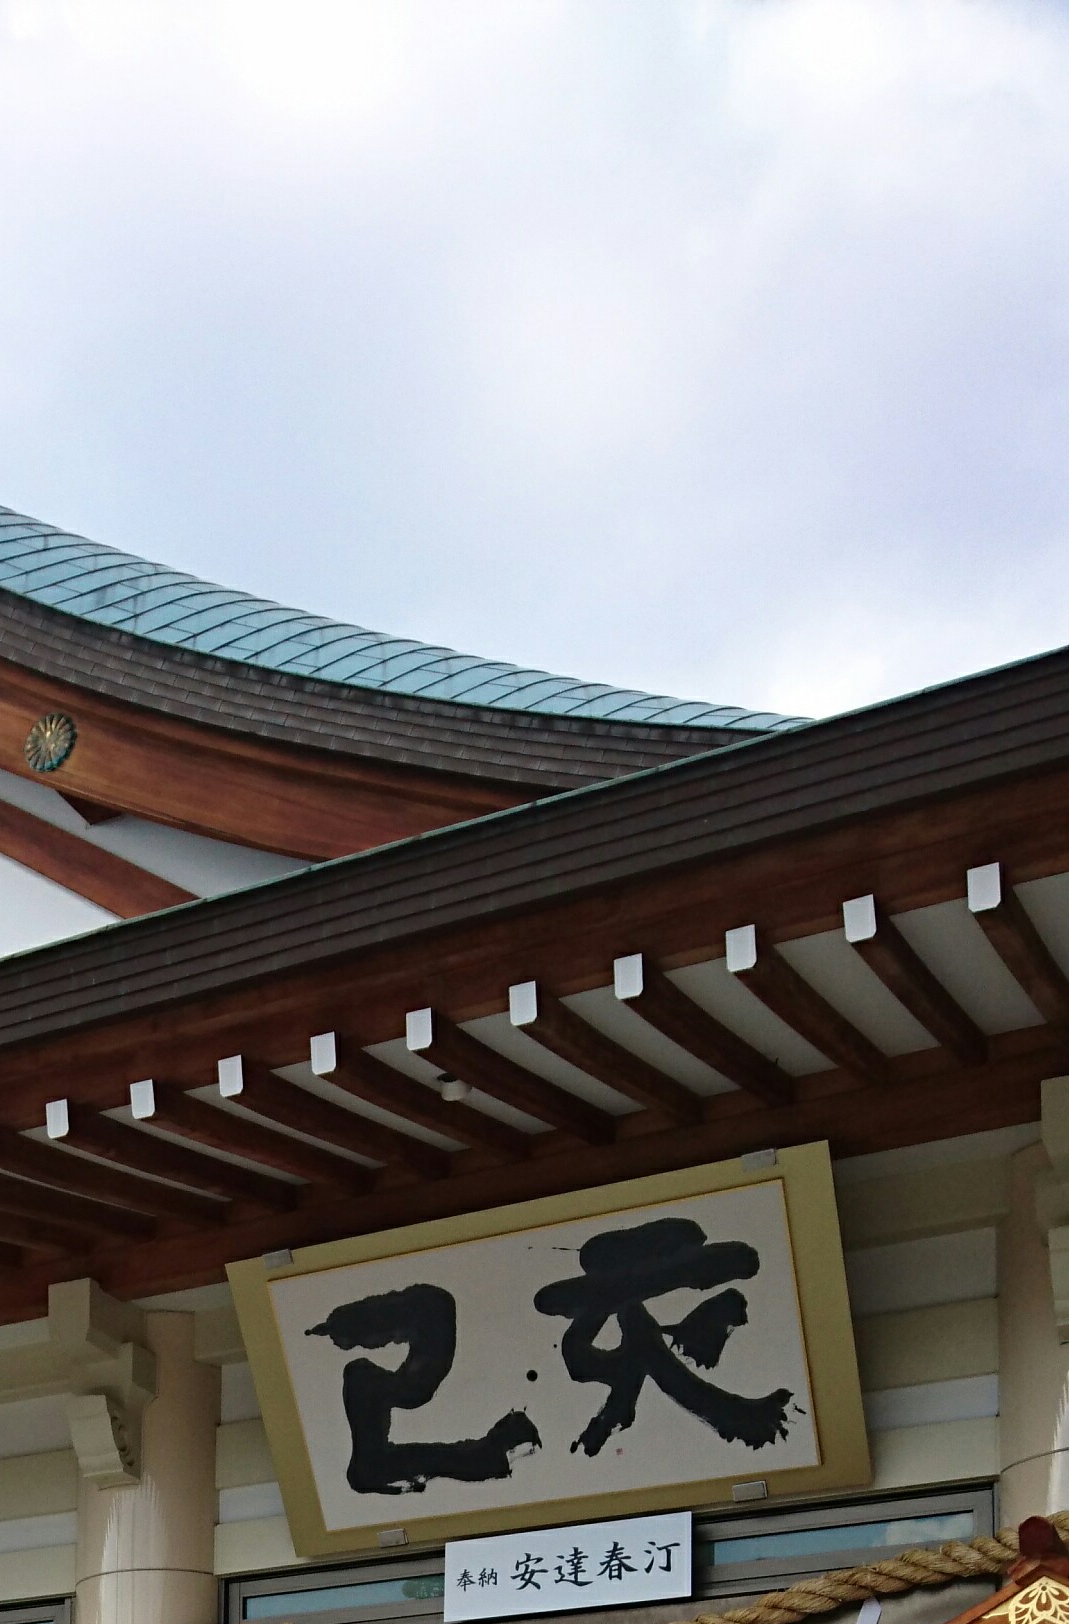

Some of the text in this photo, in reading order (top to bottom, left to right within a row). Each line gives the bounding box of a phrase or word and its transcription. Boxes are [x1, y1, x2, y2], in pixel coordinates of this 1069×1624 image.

[456, 1541, 681, 1592] 奉納 安達春汀
